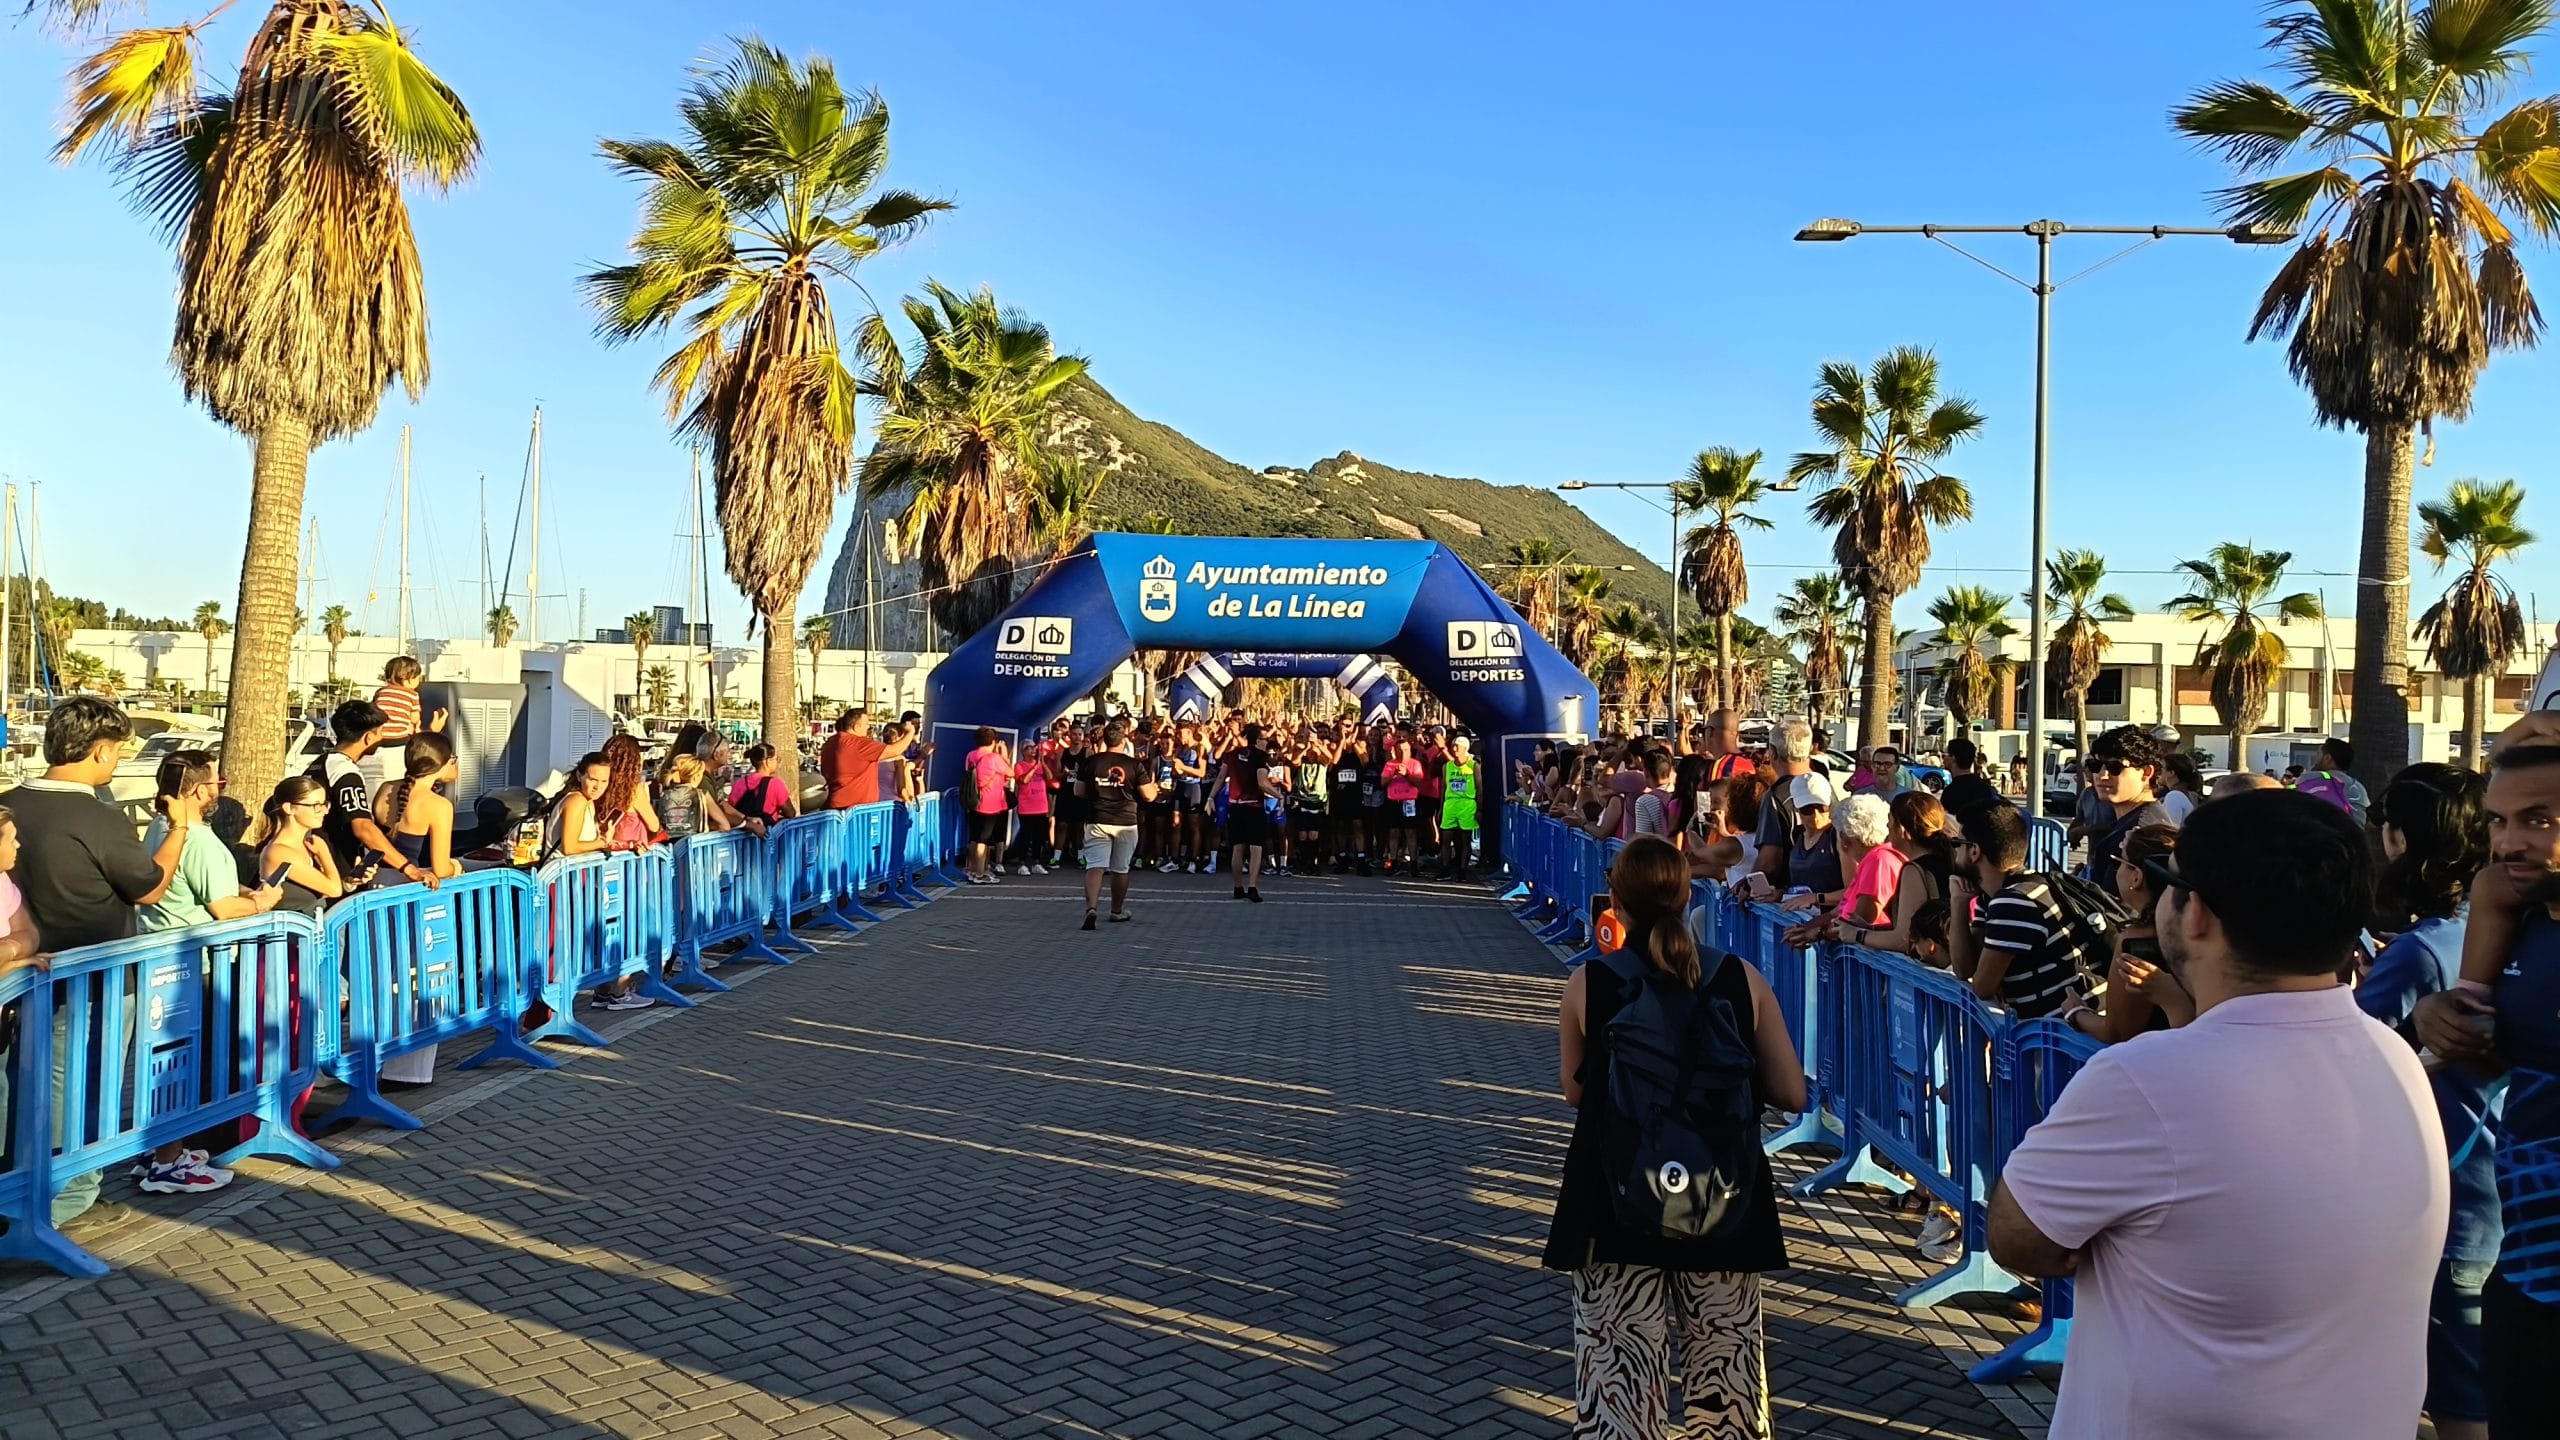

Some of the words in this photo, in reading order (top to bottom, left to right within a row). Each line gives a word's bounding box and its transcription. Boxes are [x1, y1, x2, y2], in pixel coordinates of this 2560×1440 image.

[1185, 561, 1388, 590] Ayuntamiento
[1207, 592, 1243, 617] de
[1248, 594, 1283, 618] La
[1287, 594, 1366, 618] Línea
[1006, 625, 1025, 644] D
[1457, 630, 1477, 651] D
[994, 652, 1044, 662] DELEGACIÓN
[1045, 655, 1057, 663] DE
[1258, 659, 1267, 667] de
[1449, 657, 1499, 667] DELEGACIÓN
[1499, 657, 1511, 666] DE
[993, 663, 1070, 678] DEPORTES
[1450, 668, 1525, 682] DEPORTES
[1667, 1166, 1682, 1187] 8
